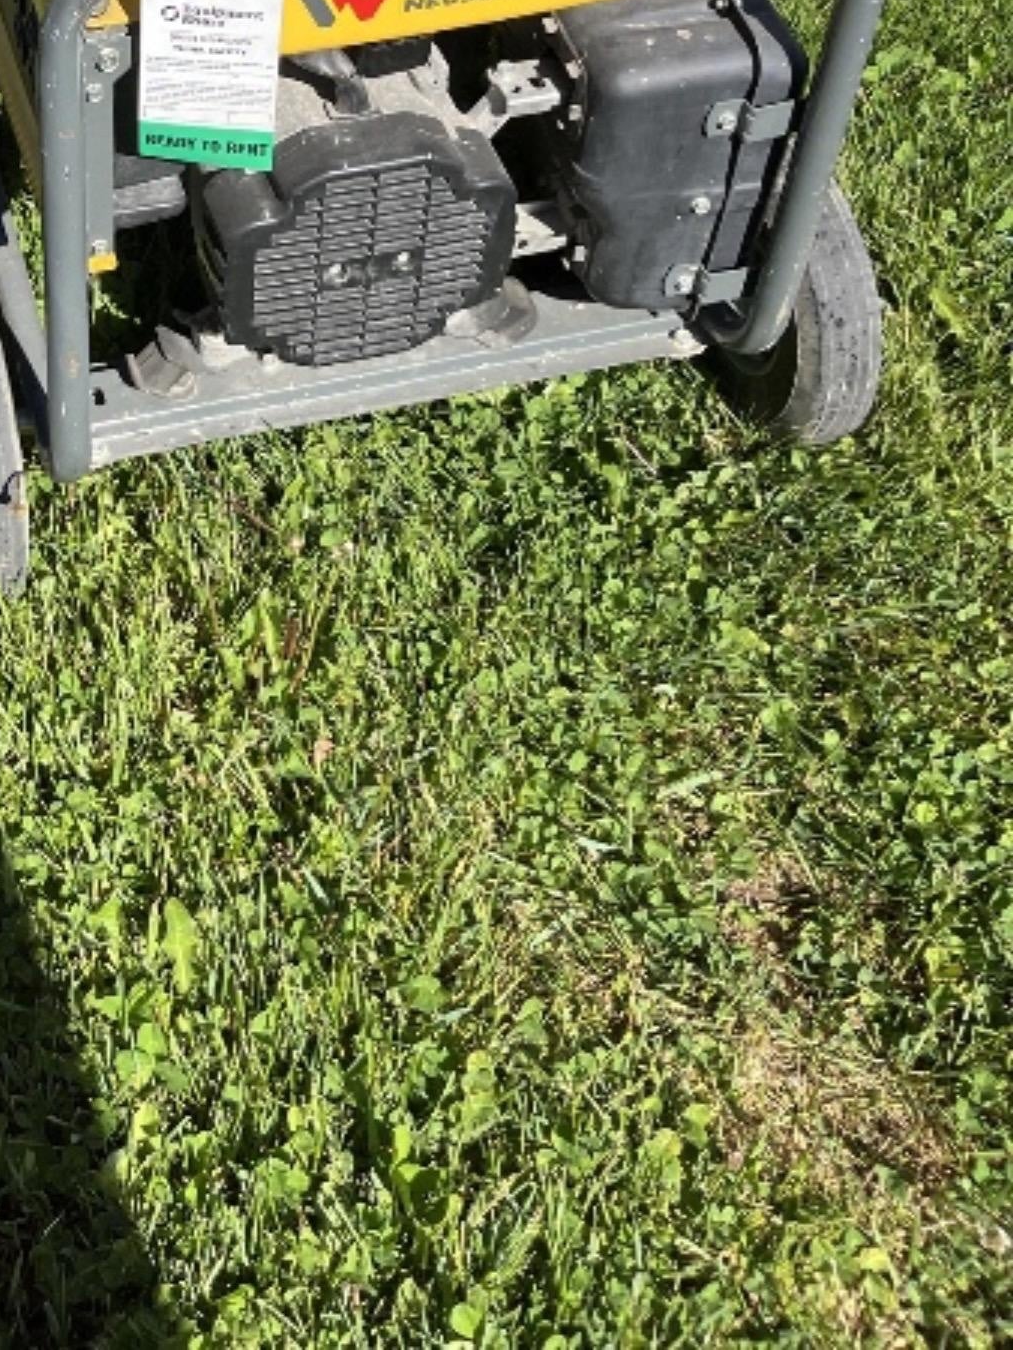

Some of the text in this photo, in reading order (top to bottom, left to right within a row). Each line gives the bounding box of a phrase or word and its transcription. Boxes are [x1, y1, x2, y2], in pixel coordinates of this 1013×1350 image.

[145, 133, 270, 157] READY TO RENT
